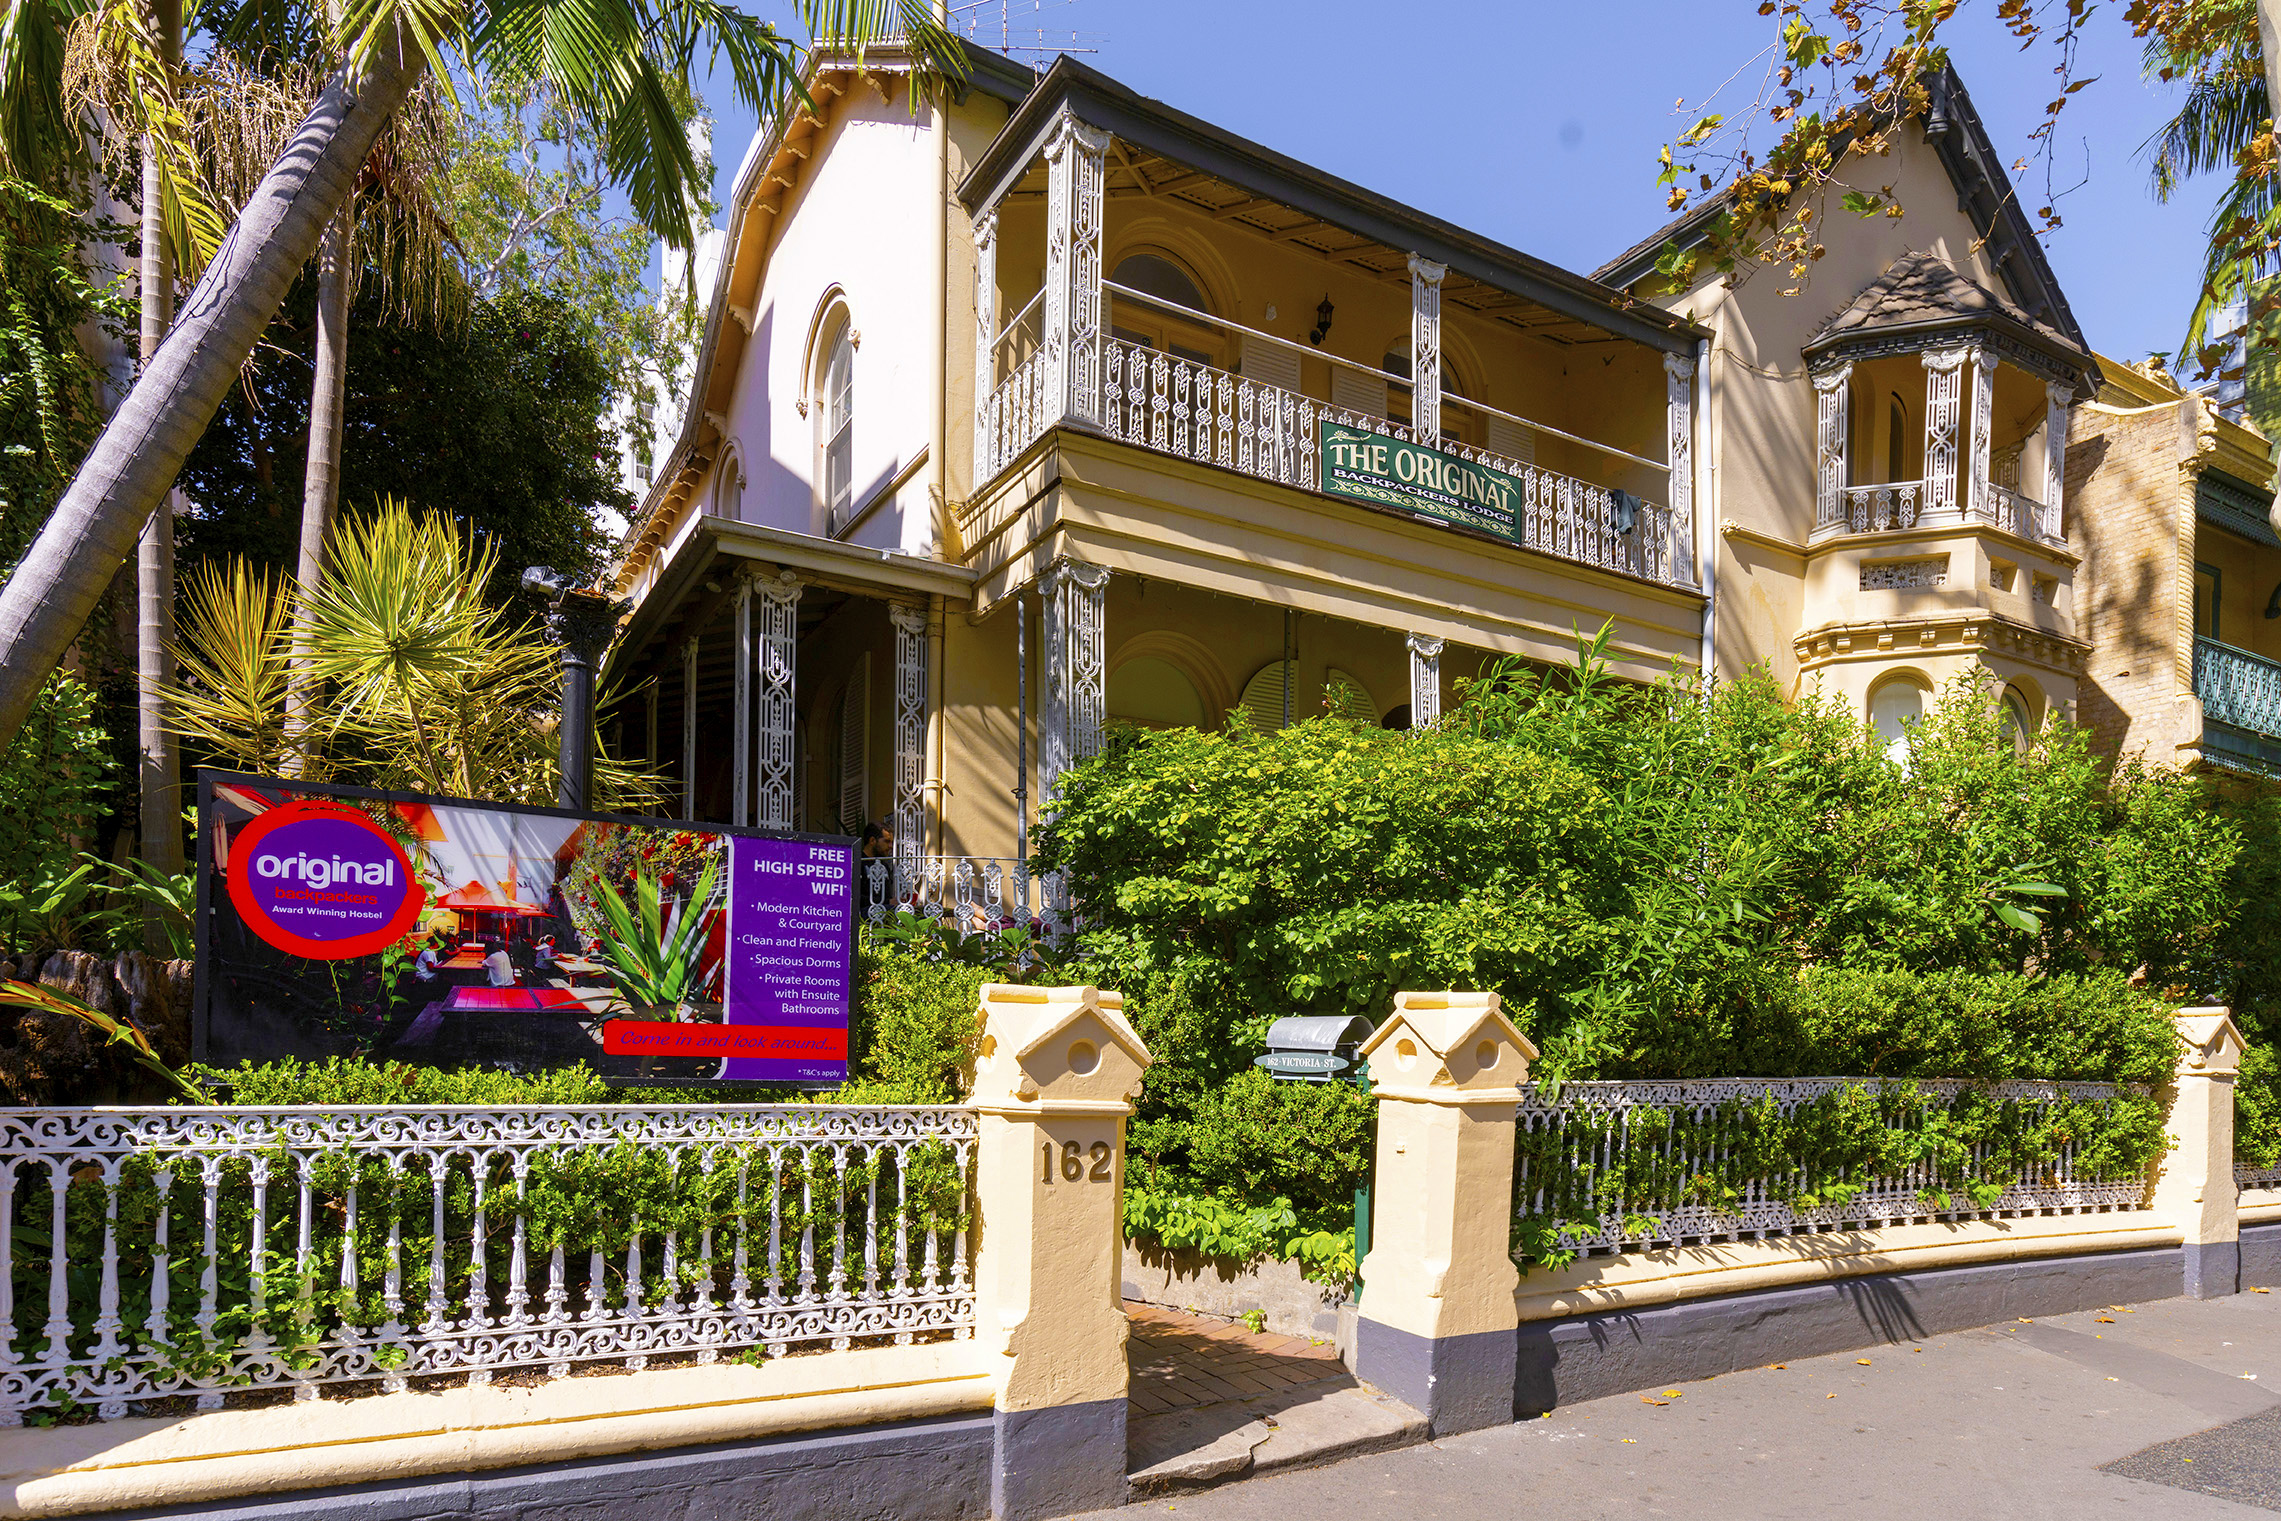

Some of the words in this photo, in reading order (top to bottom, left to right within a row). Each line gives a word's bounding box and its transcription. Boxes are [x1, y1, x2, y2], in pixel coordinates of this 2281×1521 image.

[1329, 443, 1389, 477] THE
[1395, 449, 1515, 514] ORIGINAL
[1333, 468, 1460, 507] BACKPACKERS
[1463, 501, 1514, 525] LODGE
[809, 847, 845, 862] FREE
[256, 851, 394, 890] original
[754, 860, 793, 875] HIGH
[797, 864, 844, 879] SPEED
[275, 886, 378, 905] backpackers
[272, 905, 303, 914] Award
[306, 907, 347, 919] Winning
[349, 910, 383, 919] Hostel
[757, 902, 800, 914] Modern
[802, 905, 842, 918] Kitchen
[778, 918, 787, 928] &
[789, 918, 842, 932] Courtyard
[742, 934, 773, 945] Clean
[776, 937, 796, 947] and
[799, 938, 842, 952] Friendly
[755, 953, 803, 966] Spacious
[806, 957, 841, 969] Dorms
[765, 973, 802, 985] Private
[804, 975, 841, 987] Rooms
[775, 989, 799, 999] with
[801, 990, 840, 1001] Ensuite
[782, 1003, 840, 1015] Bathrooms
[620, 1031, 670, 1046] Come
[675, 1032, 692, 1046] in
[697, 1034, 731, 1047] and
[734, 1034, 768, 1049] look
[1281, 1057, 1320, 1068] VICTORIA
[821, 1069, 841, 1078] apply
[1042, 1140, 1112, 1184] 162
